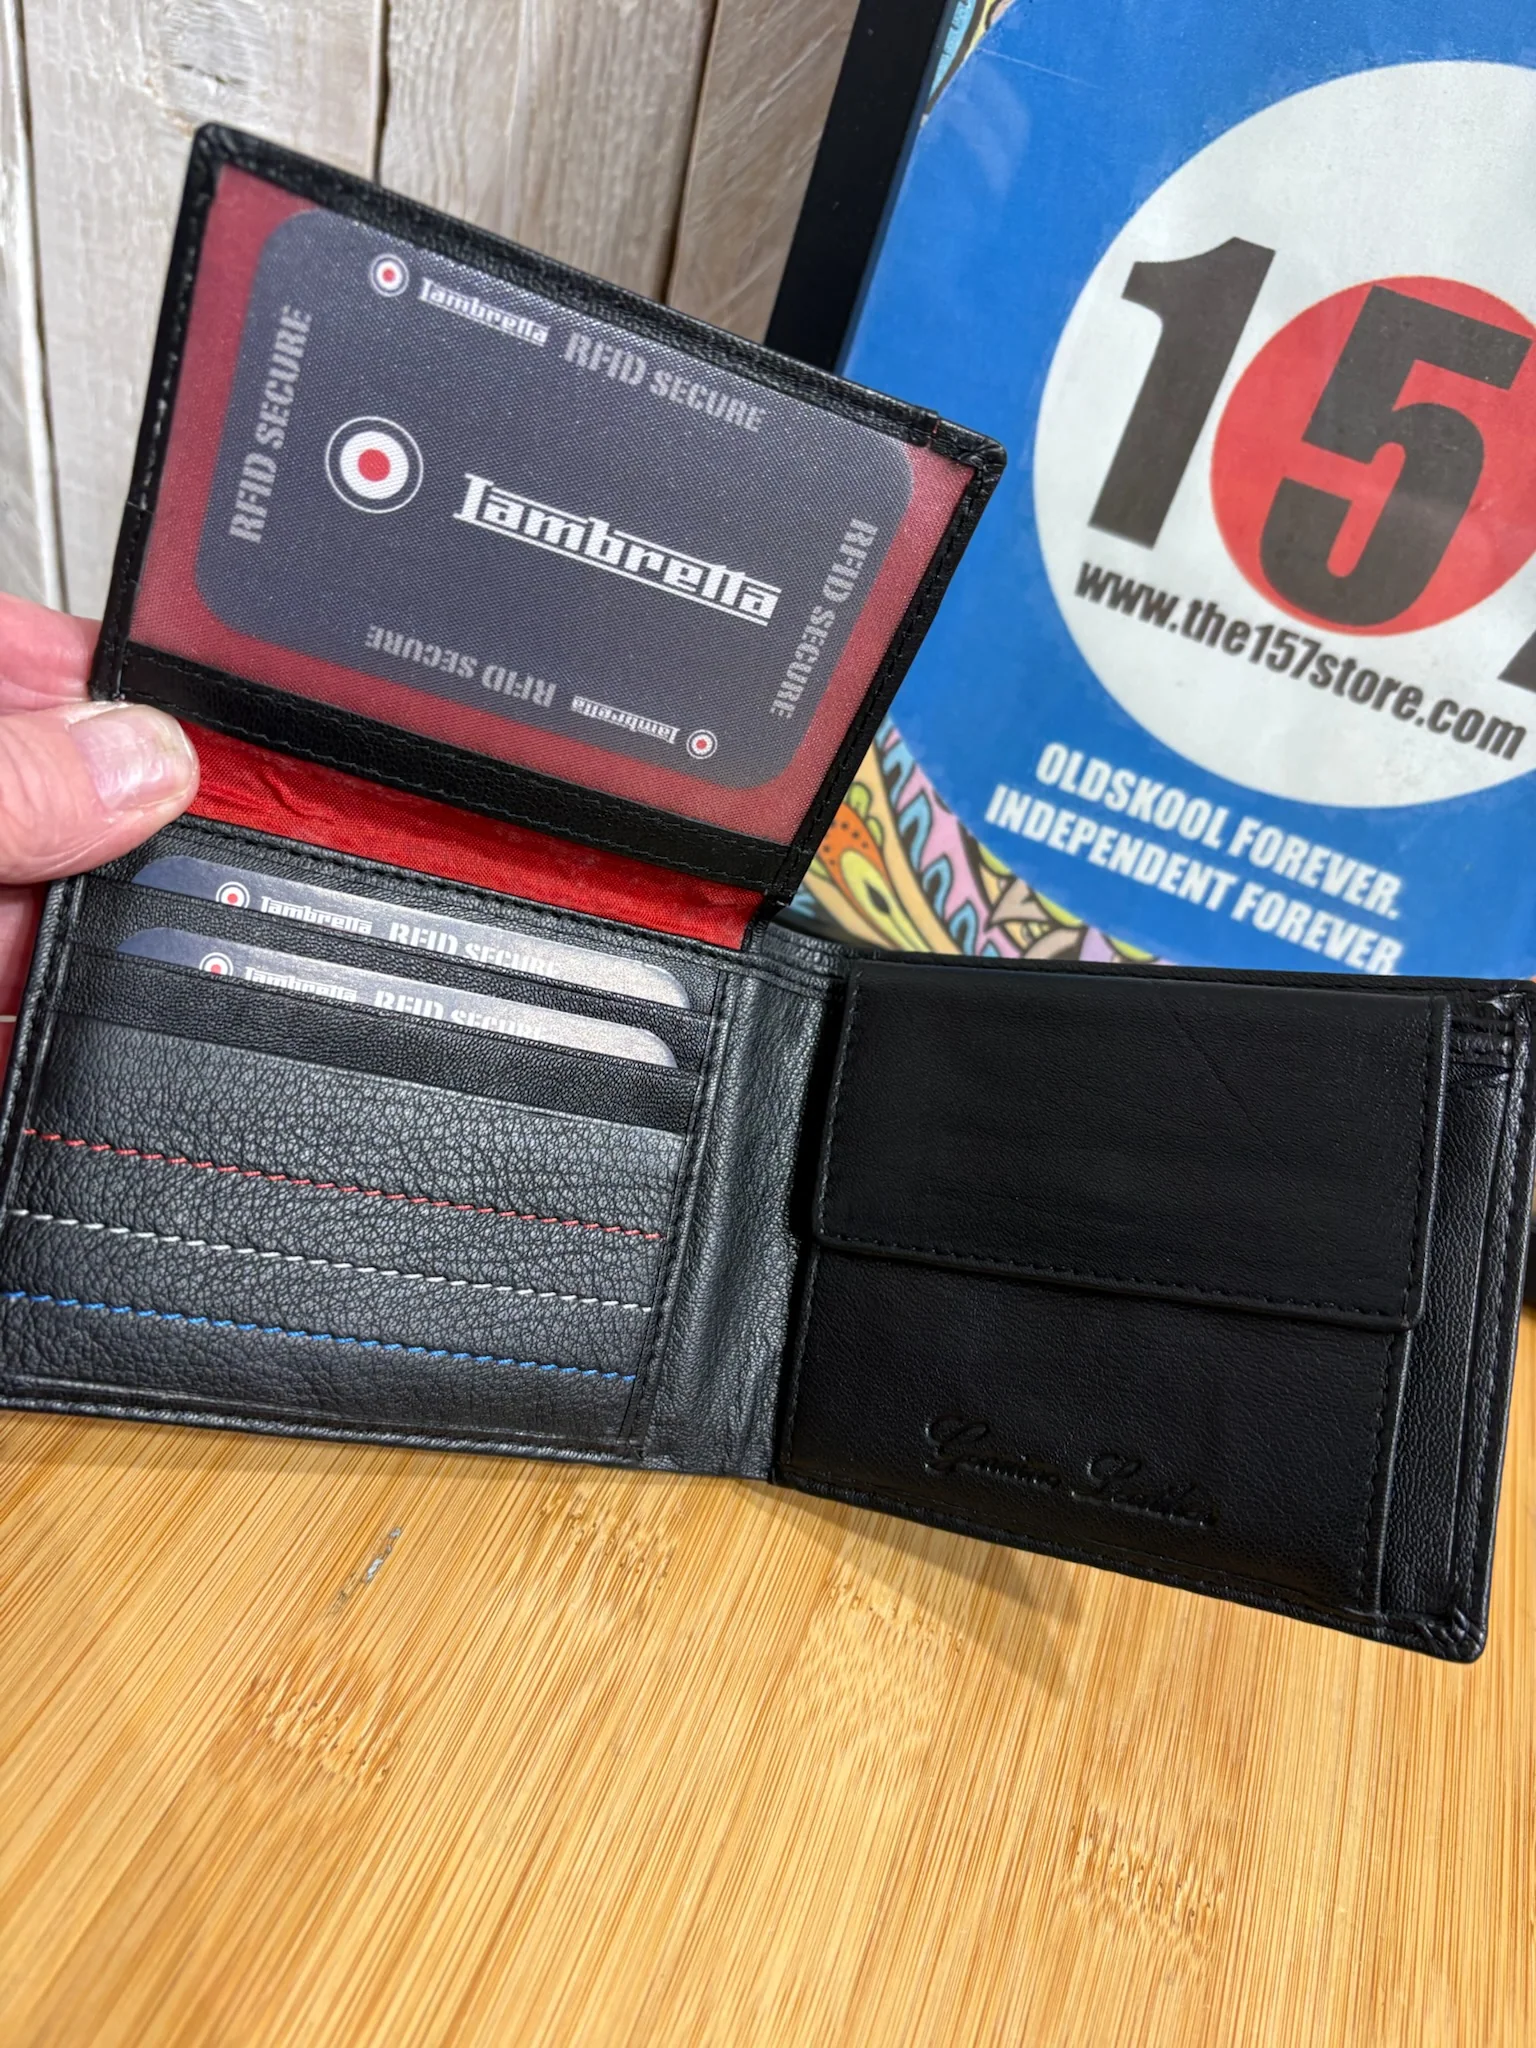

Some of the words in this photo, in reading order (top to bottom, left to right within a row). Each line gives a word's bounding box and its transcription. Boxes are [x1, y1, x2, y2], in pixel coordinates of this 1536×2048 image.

[229, 453, 277, 544] RFID
[255, 304, 312, 450] SECURE
[564, 331, 646, 386] RFID
[651, 369, 765, 432] SECURE
[453, 473, 782, 627] Lambretta
[822, 518, 878, 603] RFID
[365, 625, 478, 679] SECURE
[482, 665, 557, 707] RFID
[769, 604, 836, 719] SECURE
[1074, 562, 1527, 761] www.the157store.com
[985, 784, 1240, 912] INDEPENDENT
[1230, 881, 1405, 976] FOREVER
[1036, 742, 1230, 850] OLDSKOOL
[1228, 816, 1404, 921] FOREVER.
[389, 922, 459, 956] RFID
[463, 942, 558, 977] SECURE
[374, 990, 444, 1021] RFID
